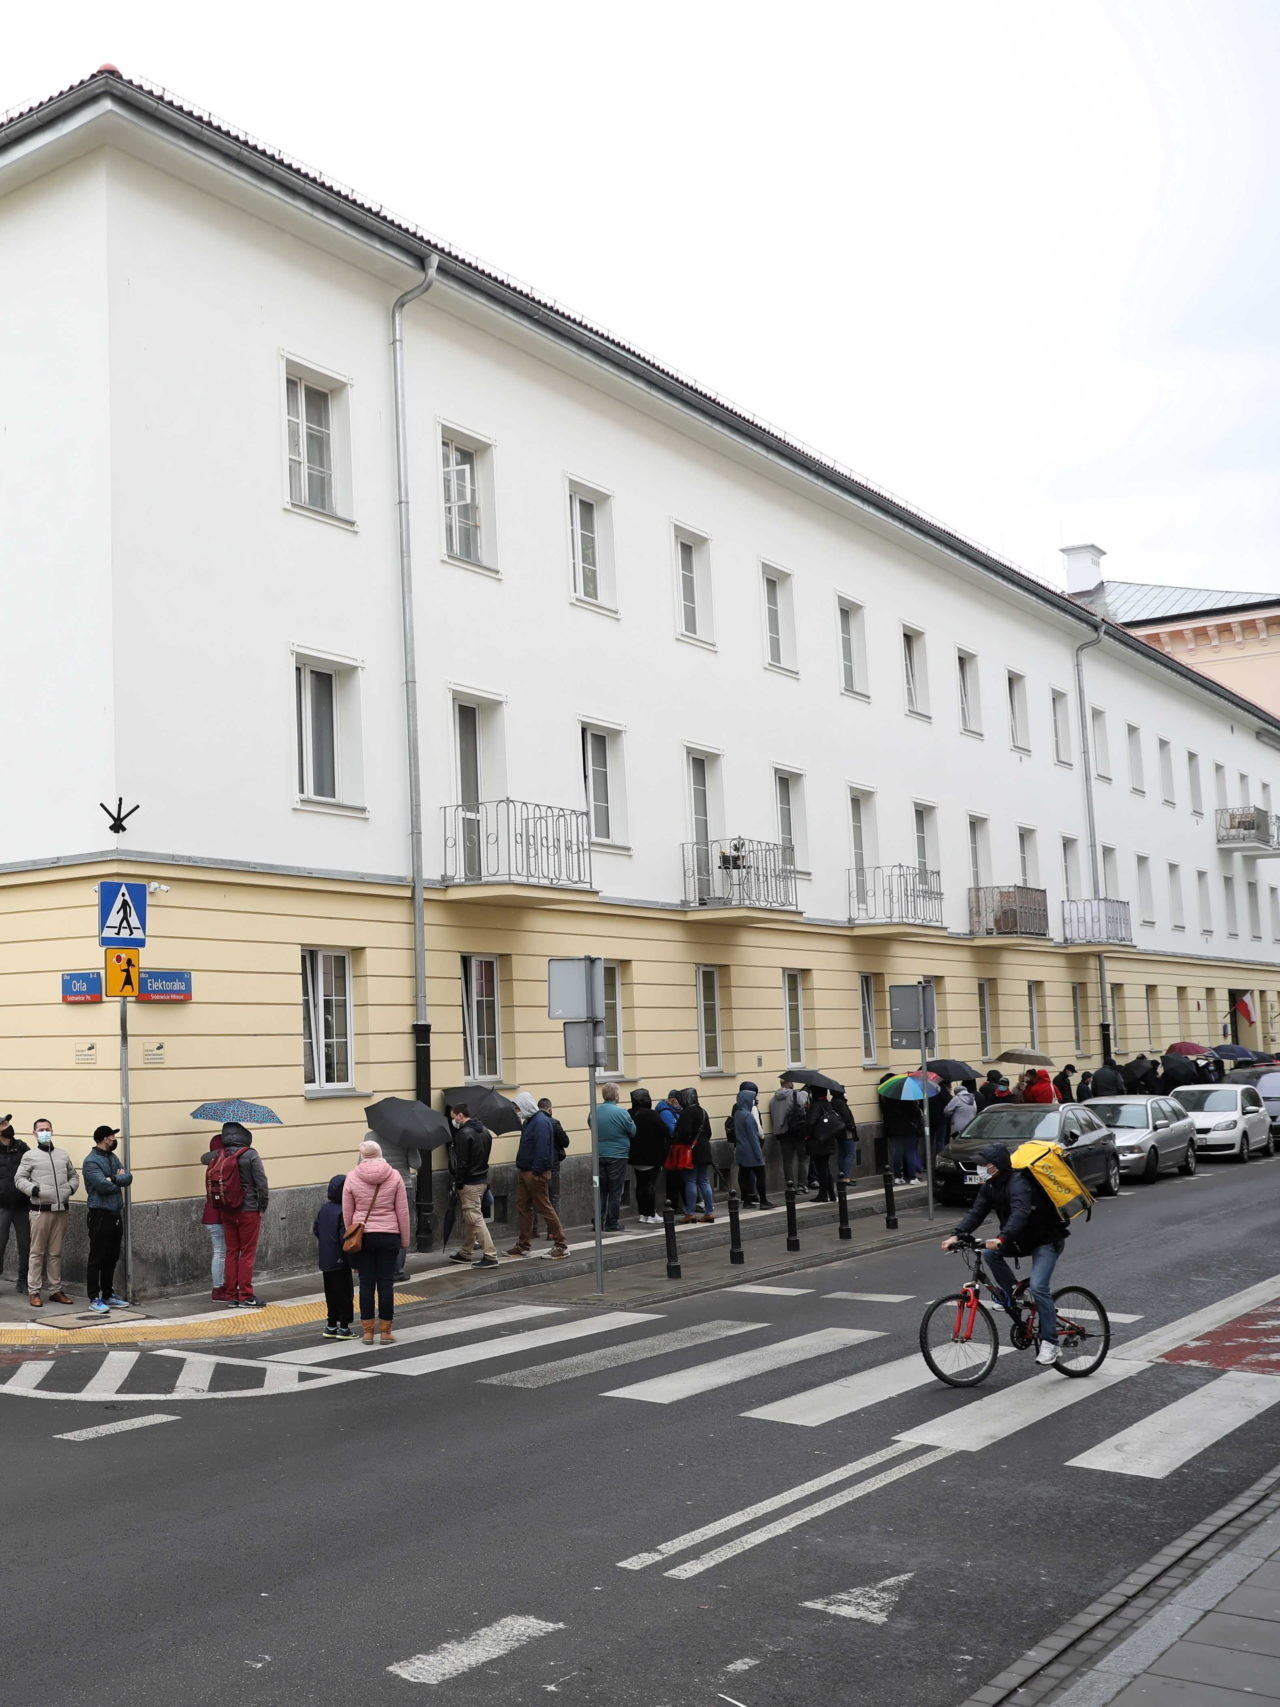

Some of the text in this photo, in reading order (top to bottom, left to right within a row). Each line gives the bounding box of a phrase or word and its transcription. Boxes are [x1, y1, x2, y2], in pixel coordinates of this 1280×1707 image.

[71, 979, 87, 992] Orla
[147, 979, 186, 991] Elektoralna
[1041, 1163, 1064, 1193] Glovo
